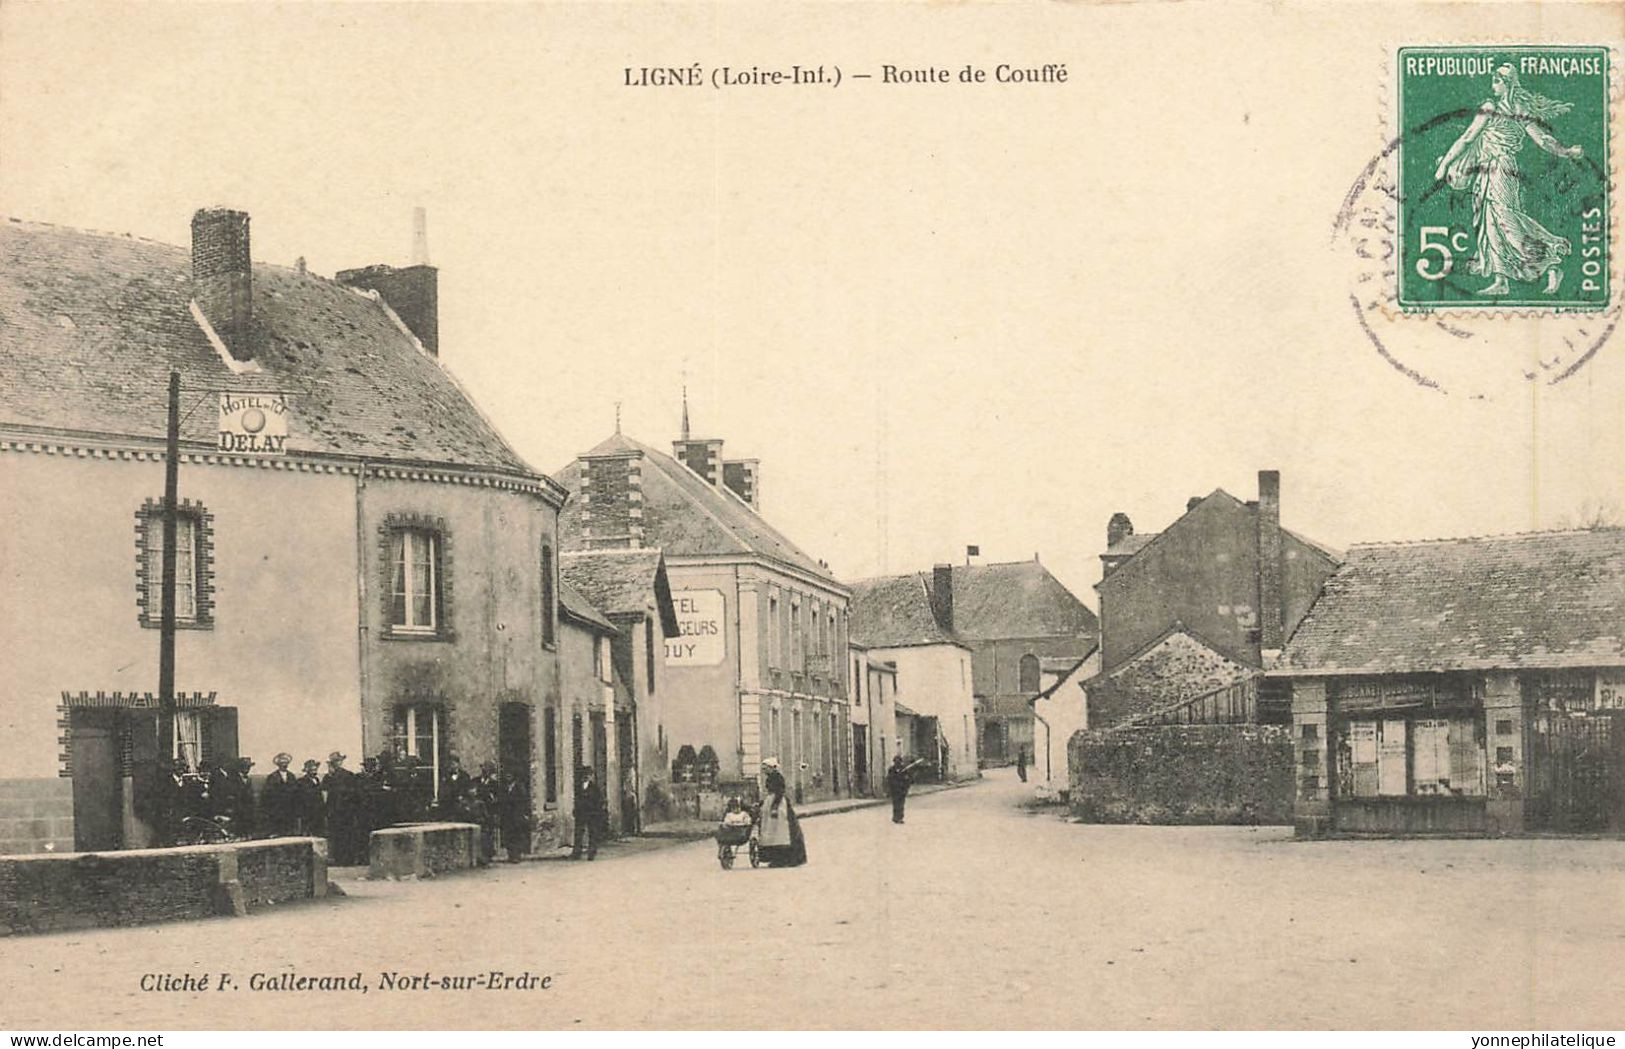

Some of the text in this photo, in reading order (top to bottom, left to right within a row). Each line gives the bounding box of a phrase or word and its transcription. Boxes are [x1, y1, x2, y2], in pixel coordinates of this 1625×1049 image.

[624, 62, 703, 87] LIGNÉ
[882, 65, 950, 84] Route
[958, 64, 986, 83] de
[995, 63, 1068, 83] Couffé
[1520, 56, 1601, 77] FRANÇAISE
[1582, 206, 1602, 292] POSTES
[221, 396, 263, 416] HOTEL
[219, 431, 287, 453] DELAY
[140, 971, 552, 994] Cliché F. Gallerand, Nort-sur-Erdre
